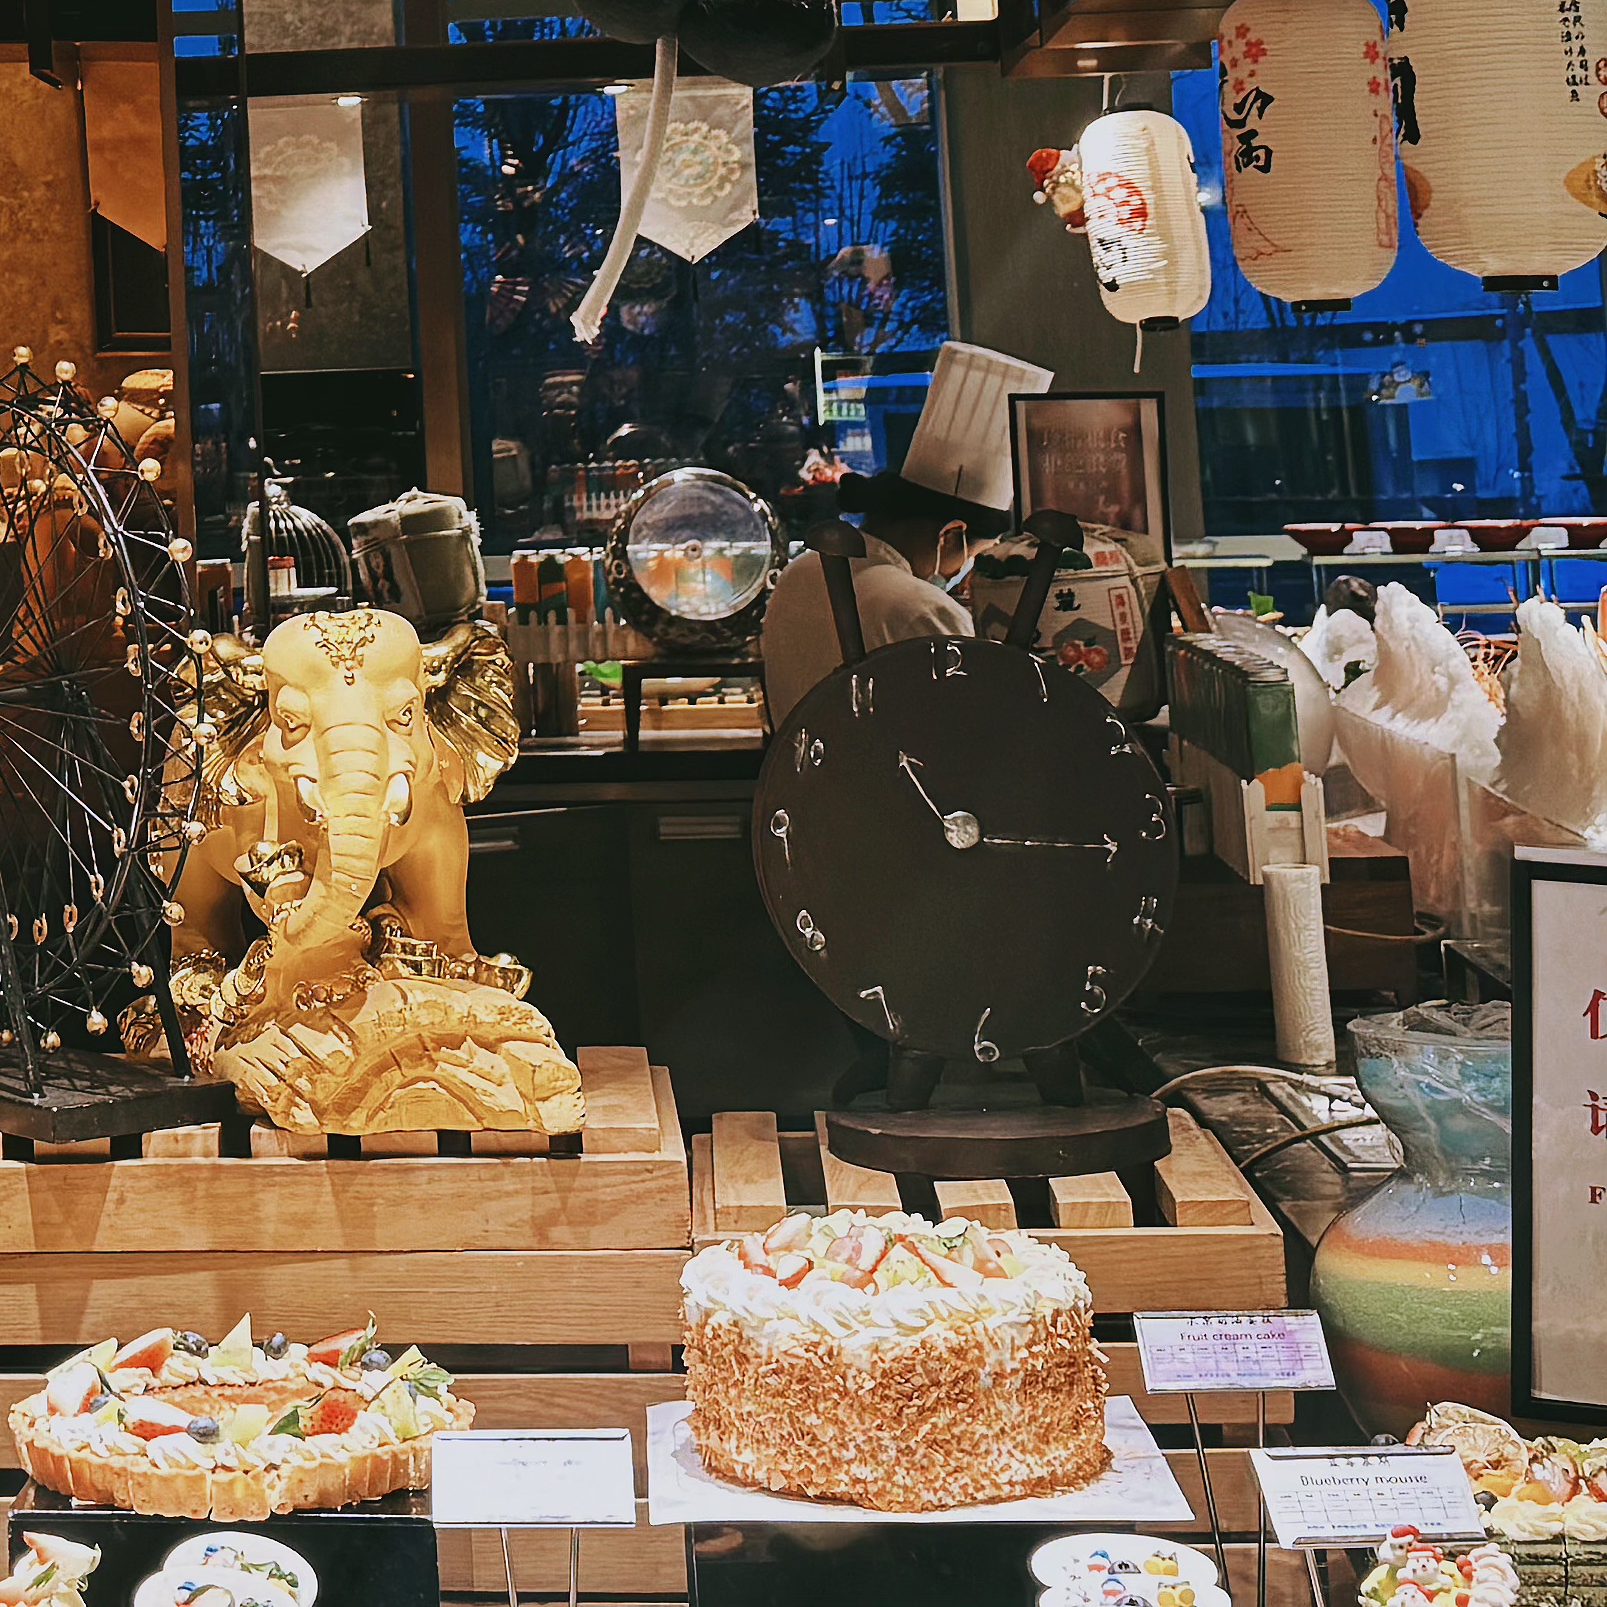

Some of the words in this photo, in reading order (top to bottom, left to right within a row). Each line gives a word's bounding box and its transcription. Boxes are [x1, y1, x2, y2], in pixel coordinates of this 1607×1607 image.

[930, 640, 968, 680] 12
[851, 673, 874, 717] 11
[796, 727, 825, 773] 10
[1105, 715, 1134, 756] 2
[1139, 792, 1167, 841] 3
[770, 808, 792, 871] 9
[796, 908, 826, 952] 8
[1132, 895, 1166, 938] 4
[860, 985, 896, 1031] 7
[1080, 964, 1107, 1014] 5
[973, 1006, 1001, 1063] 6
[1212, 1333, 1253, 1342] cream
[1256, 1330, 1286, 1341] cake
[1299, 1475, 1369, 1487] Blueberry
